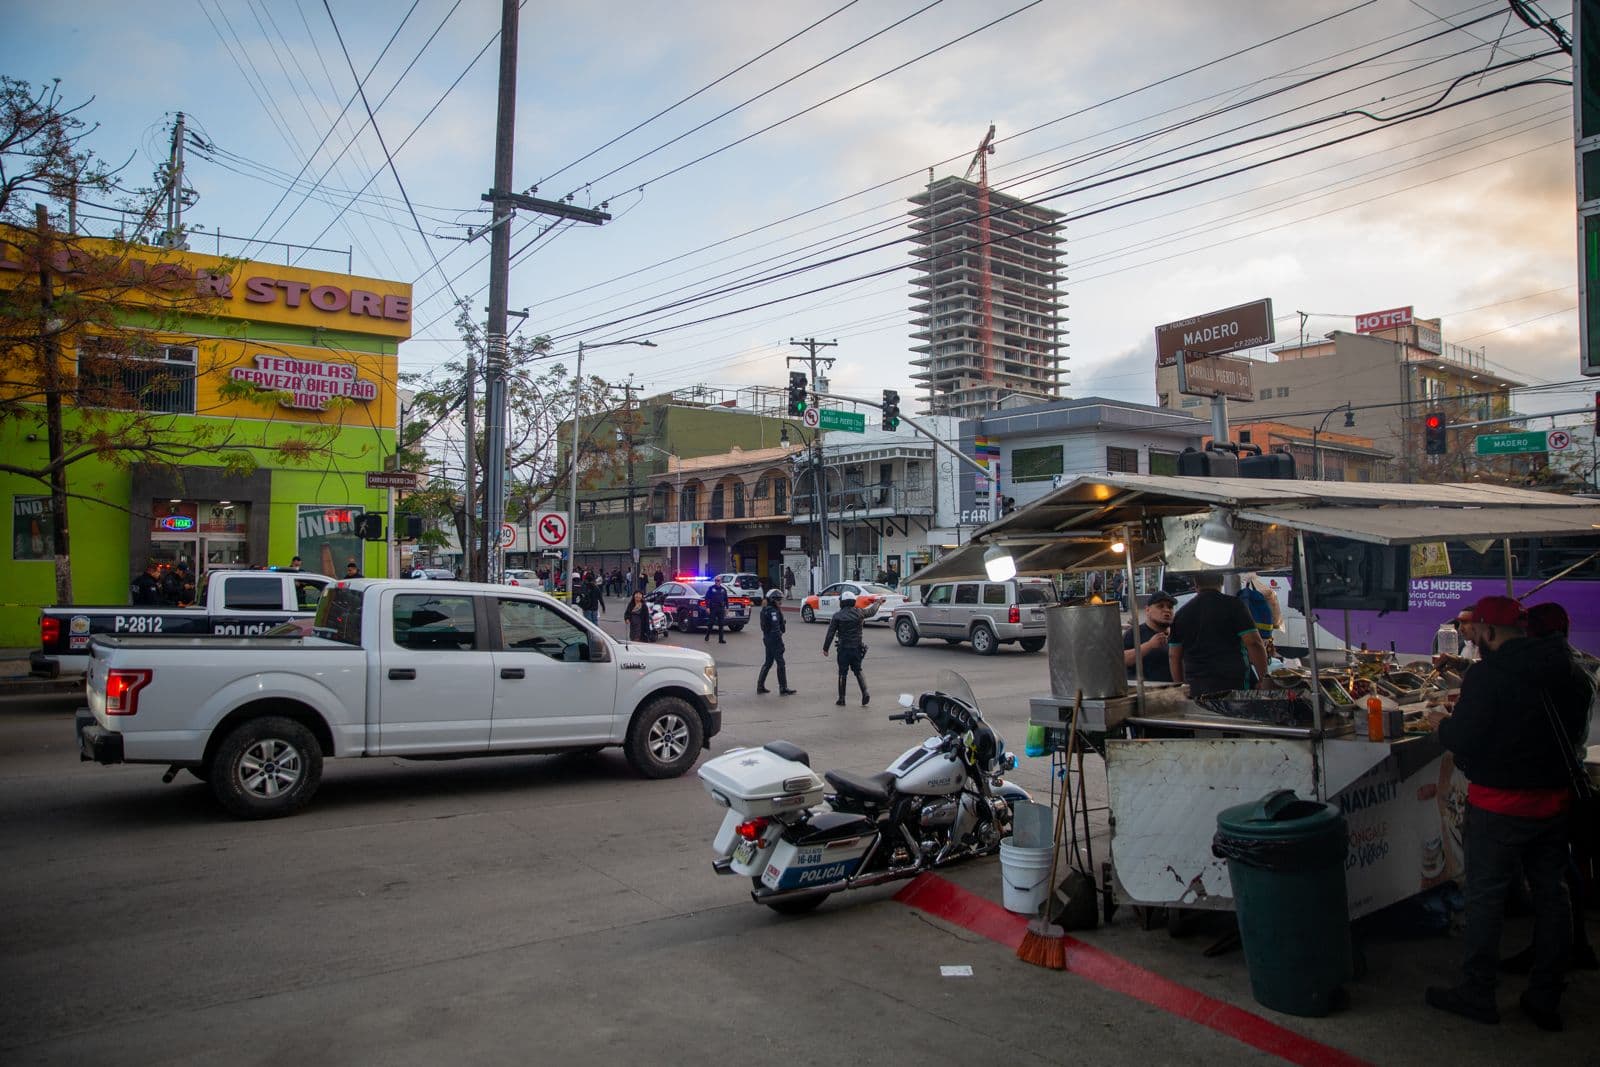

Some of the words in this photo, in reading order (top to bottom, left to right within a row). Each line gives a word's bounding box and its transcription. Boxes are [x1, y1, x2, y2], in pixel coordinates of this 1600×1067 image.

[245, 276, 410, 321] STORE
[1357, 310, 1411, 330] HOTEL
[1184, 321, 1238, 346] MADERO
[262, 357, 353, 380] TEQUILAS
[1188, 364, 1214, 382] CARRILLO
[1215, 368, 1235, 385] PUERTO
[307, 379, 339, 395] BIEN
[1494, 438, 1529, 448] MADERO
[1412, 580, 1429, 590] LAS
[1431, 581, 1472, 591] MUJERES
[1408, 591, 1427, 599] vicio
[1428, 591, 1461, 600] Gratuito
[1424, 599, 1446, 608] Niños
[115, 616, 163, 633] P-2812
